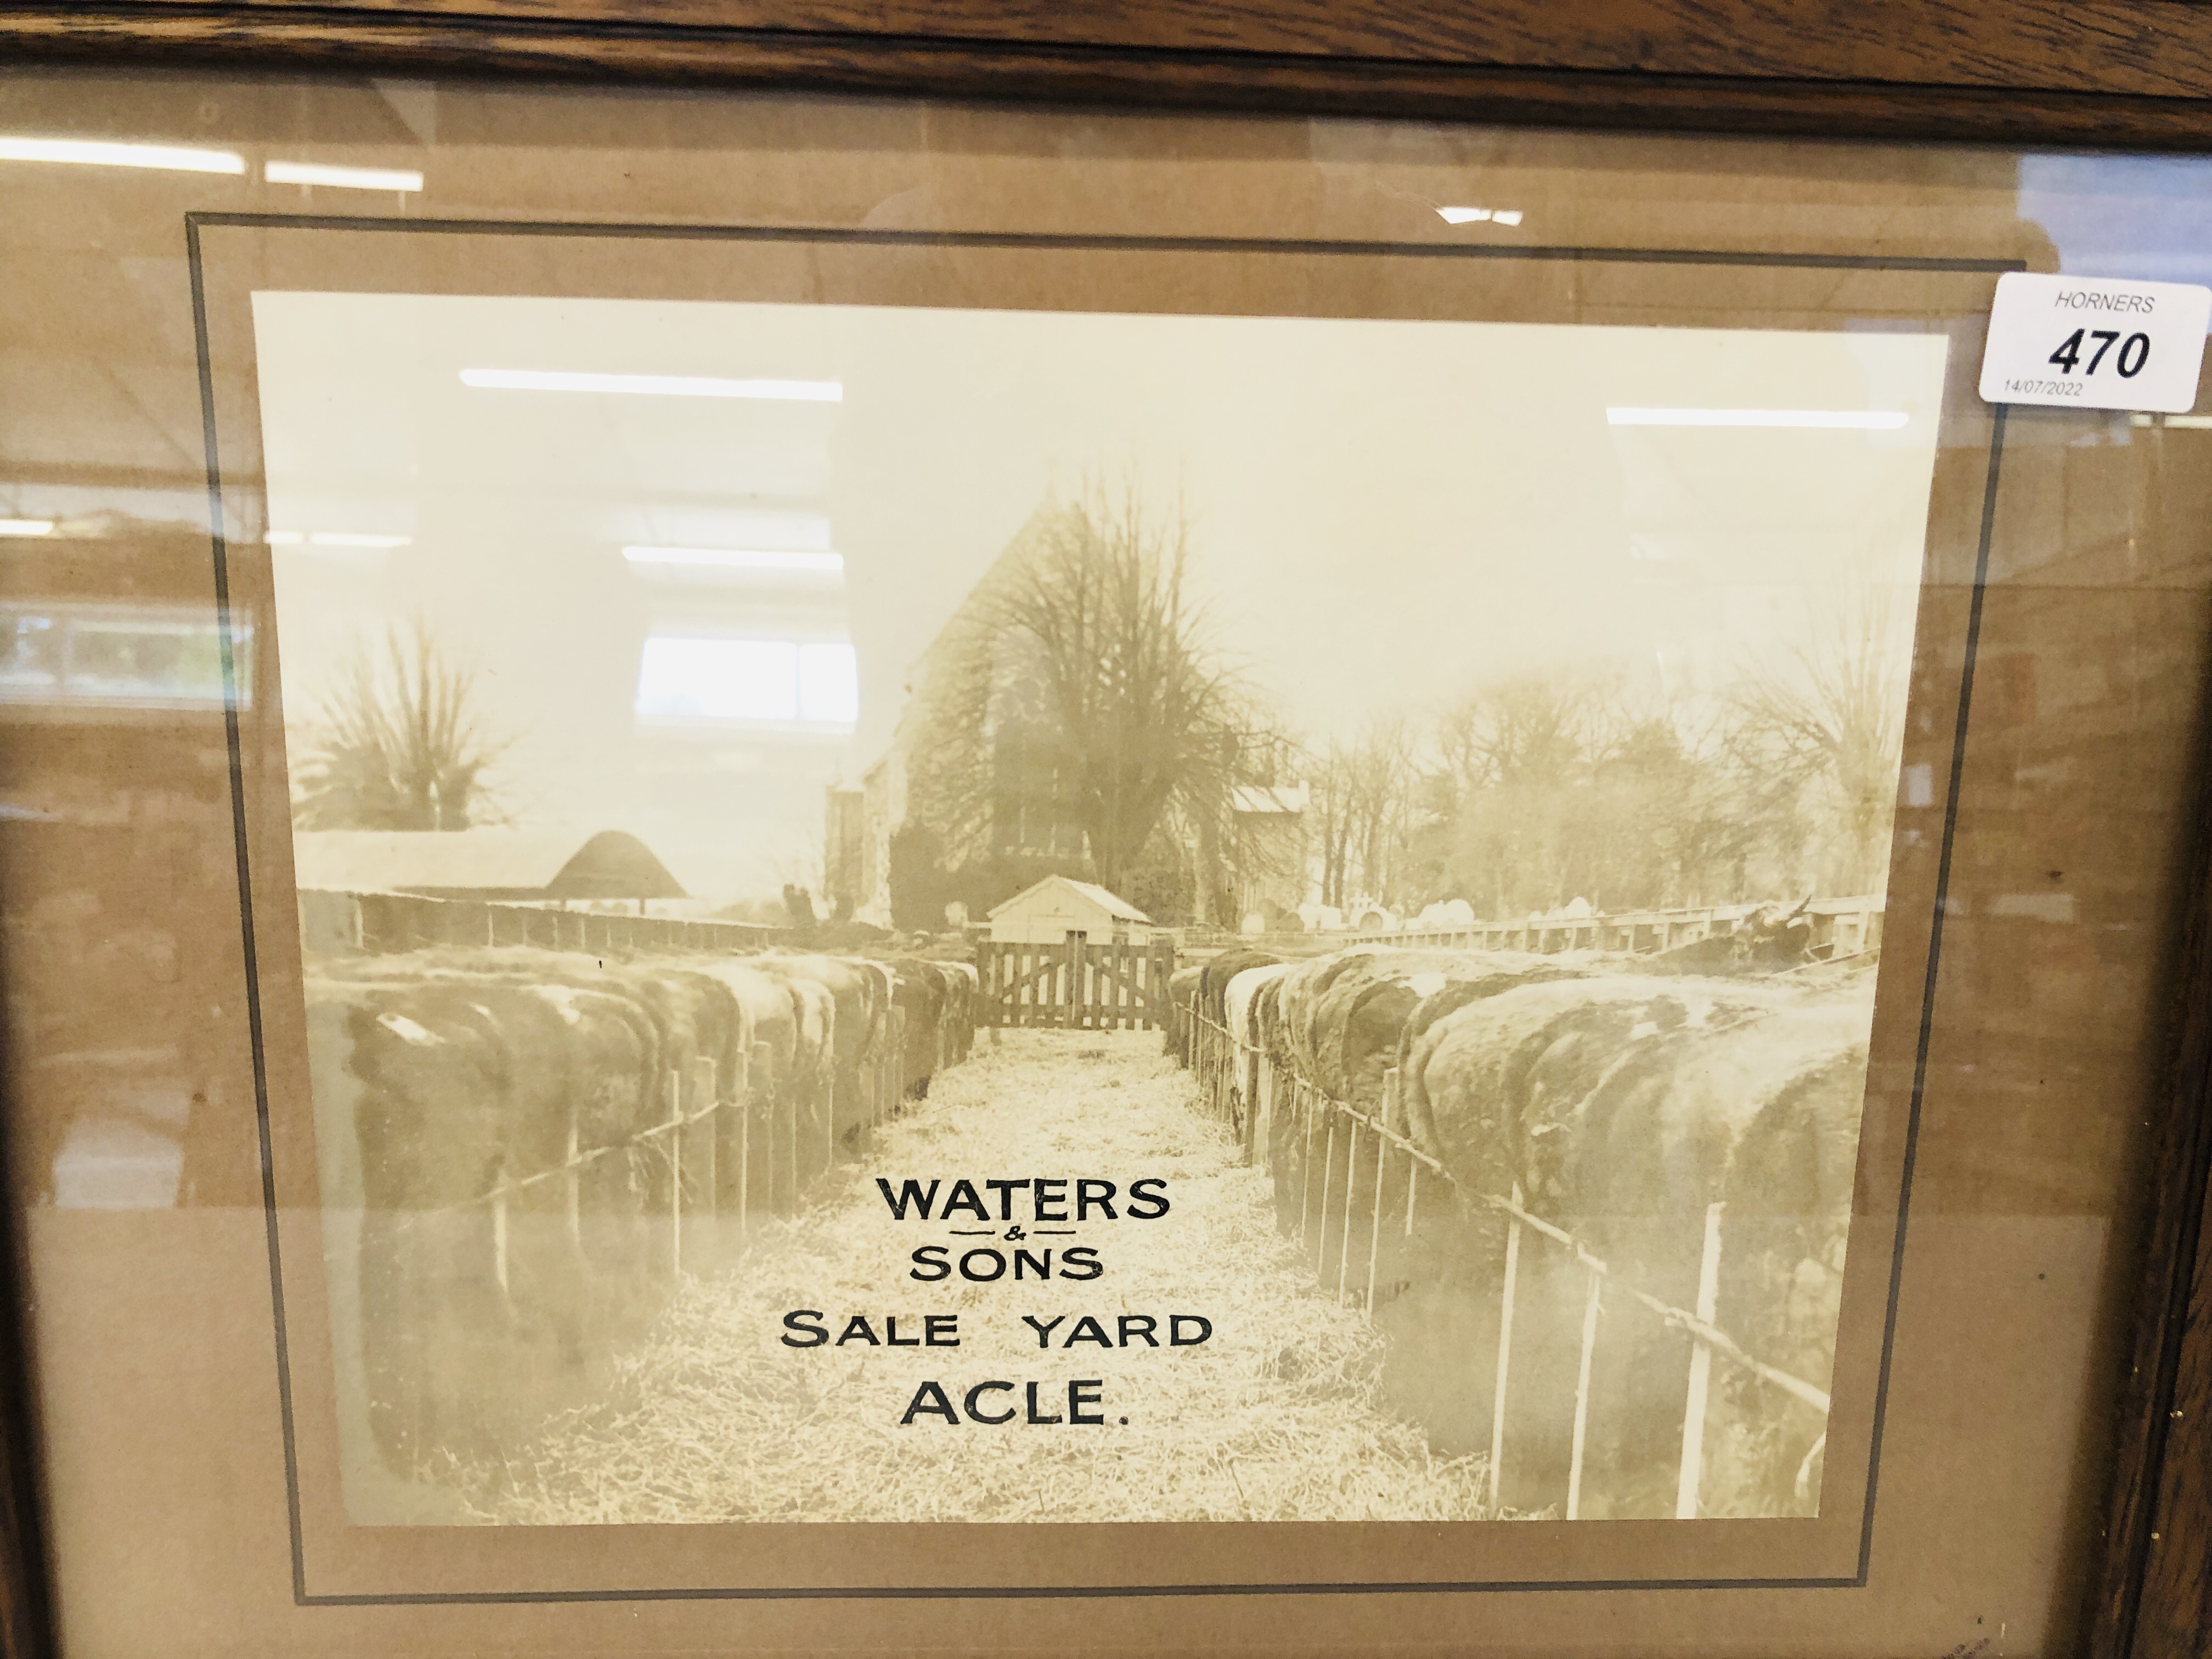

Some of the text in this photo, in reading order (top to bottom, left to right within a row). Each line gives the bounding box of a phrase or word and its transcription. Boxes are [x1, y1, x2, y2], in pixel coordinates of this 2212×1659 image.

[2054, 290, 2156, 313] HORNERS
[2049, 328, 2150, 379] 470
[2004, 379, 2083, 397] 14/07/2022
[875, 1178, 1171, 1222] WATERS
[1003, 1225, 1026, 1242] &
[909, 1245, 1104, 1282] SONS
[780, 1310, 1213, 1349] SALE YARD
[900, 1379, 1129, 1425] ACLE.
